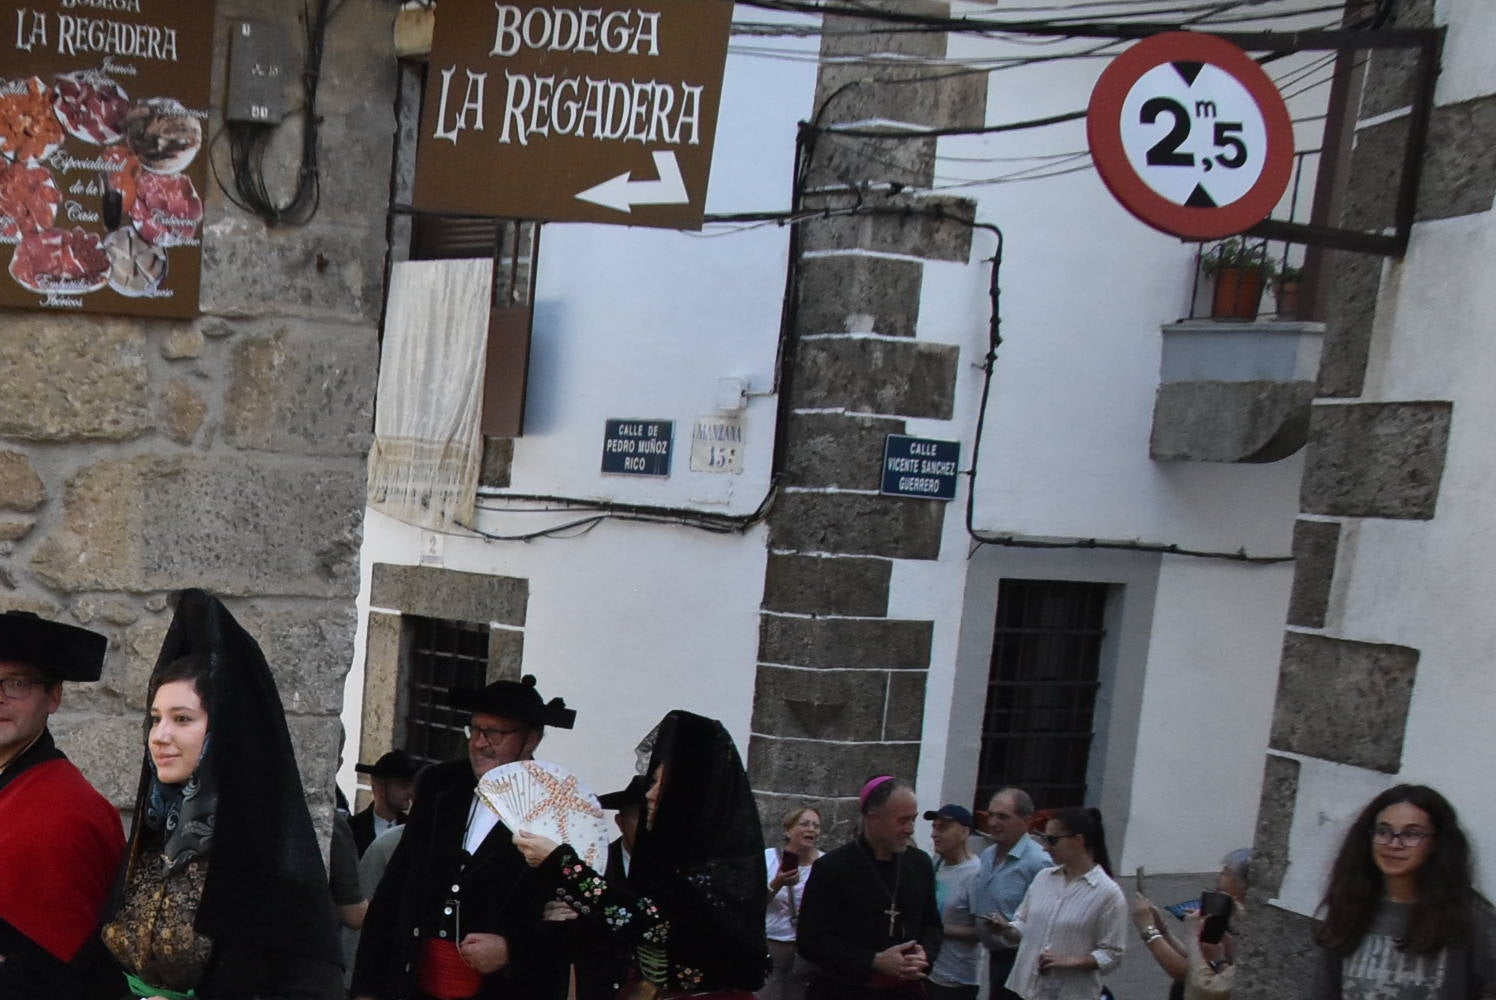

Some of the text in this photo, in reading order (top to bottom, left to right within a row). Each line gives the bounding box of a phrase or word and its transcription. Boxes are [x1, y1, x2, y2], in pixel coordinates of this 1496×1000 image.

[15, 7, 178, 61] LA REGADERA
[489, 2, 661, 57] BODEGA
[433, 64, 704, 146] LA REGADERA
[619, 424, 659, 437] CALLE DE
[607, 438, 667, 455] PEDRO MUÑOZ
[910, 442, 937, 456] CALLE
[625, 457, 645, 471] RICO
[888, 457, 919, 473] VICENTE
[899, 476, 940, 493] GUERRERO
